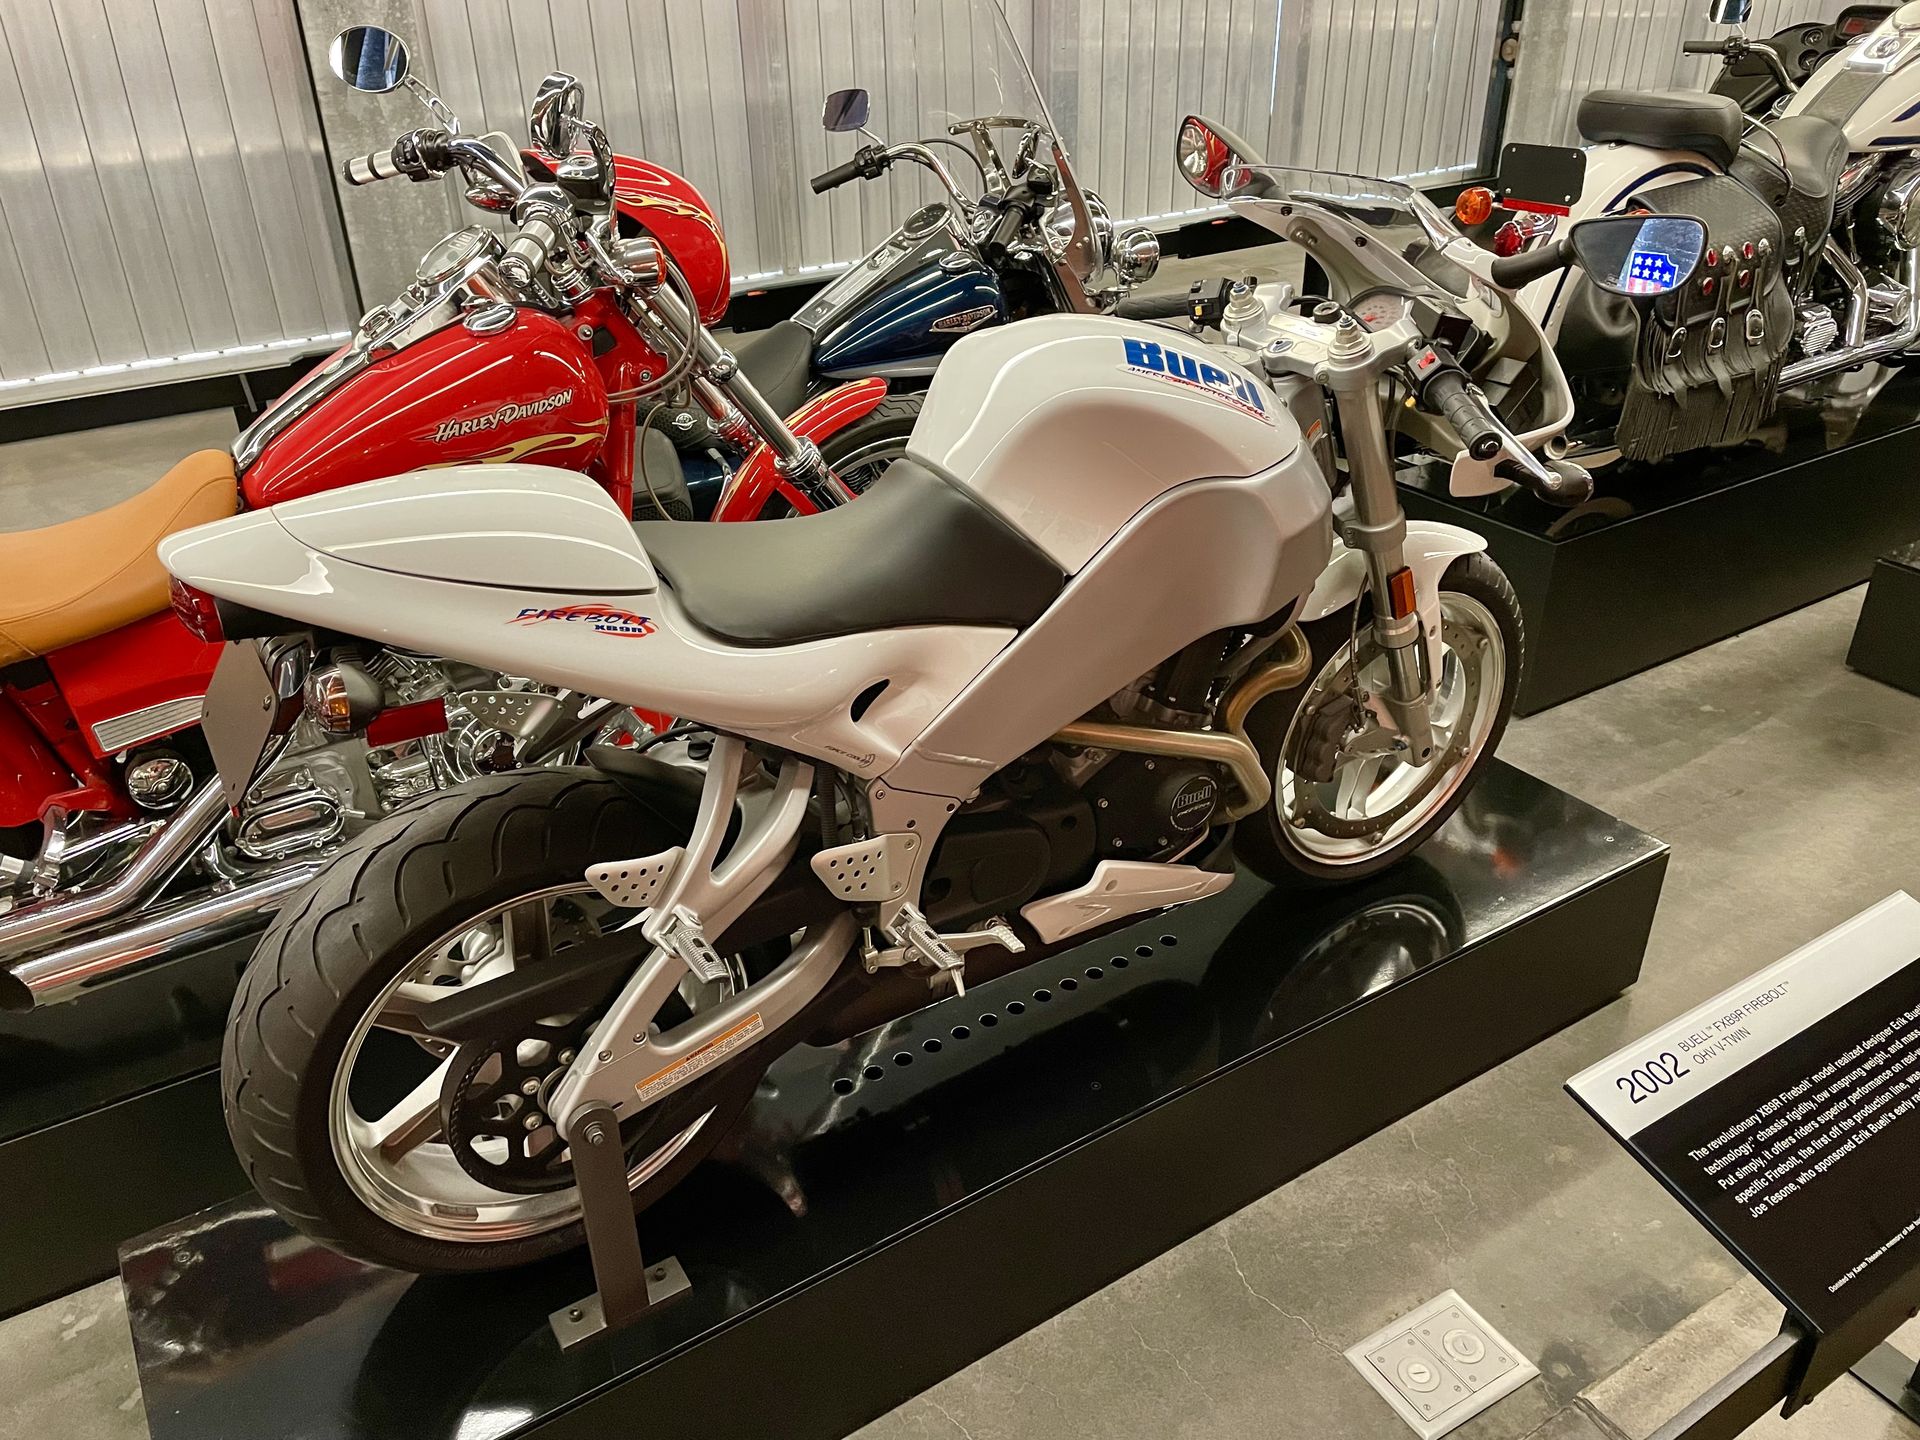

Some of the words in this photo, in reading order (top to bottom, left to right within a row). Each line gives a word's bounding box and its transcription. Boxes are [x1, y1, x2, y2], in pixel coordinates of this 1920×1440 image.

[1123, 339, 1265, 412] Buell
[432, 388, 573, 443] HARLEY-DAVIDSON
[516, 609, 652, 626] FIREBOLT
[595, 624, 643, 633] XB9R
[1177, 785, 1211, 808] Buell
[1693, 1046, 1717, 1064] OHV
[1713, 1026, 1751, 1051] V-TWIN
[1712, 1009, 1747, 1032] FXB9R
[1616, 1052, 1691, 1104] 2002
[1688, 1147, 1709, 1161] The
[1707, 1113, 1762, 1151] revolutionary
[1756, 1098, 1783, 1118] XB9R
[1811, 1063, 1837, 1083] model
[1834, 1045, 1865, 1068] realized
[1862, 1027, 1894, 1050] designer
[1889, 1017, 1908, 1030] Erik
[1756, 1118, 1788, 1142] chassis
[1785, 1100, 1818, 1122] rigidity,
[1812, 1090, 1830, 1103] low
[1828, 1067, 1867, 1094] unsprung
[1862, 1051, 1892, 1071] weight,
[1887, 1040, 1904, 1054] and
[1718, 1174, 1738, 1190] Put
[1735, 1157, 1768, 1179] simply,
[1761, 1150, 1774, 1160] it
[1771, 1136, 1796, 1155] offers
[1794, 1120, 1819, 1139] riders
[1817, 1099, 1850, 1124] superior
[1847, 1070, 1894, 1105] performance
[1891, 1063, 1904, 1073] on
[1735, 1178, 1769, 1204] specific
[1764, 1156, 1803, 1182] Firebolt,
[1797, 1146, 1815, 1159] the
[1811, 1134, 1832, 1150] first
[1829, 1125, 1843, 1138] off
[1838, 1118, 1855, 1131] the
[1852, 1092, 1894, 1124] production
[1889, 1082, 1910, 1095] line,
[1749, 1203, 1768, 1218] Joe
[1763, 1183, 1801, 1206] Tesone,
[1796, 1169, 1816, 1184] who
[1814, 1139, 1856, 1173] sponsored
[1851, 1129, 1872, 1144] Erik
[1867, 1112, 1896, 1133] Buell's
[1894, 1099, 1915, 1115] early
